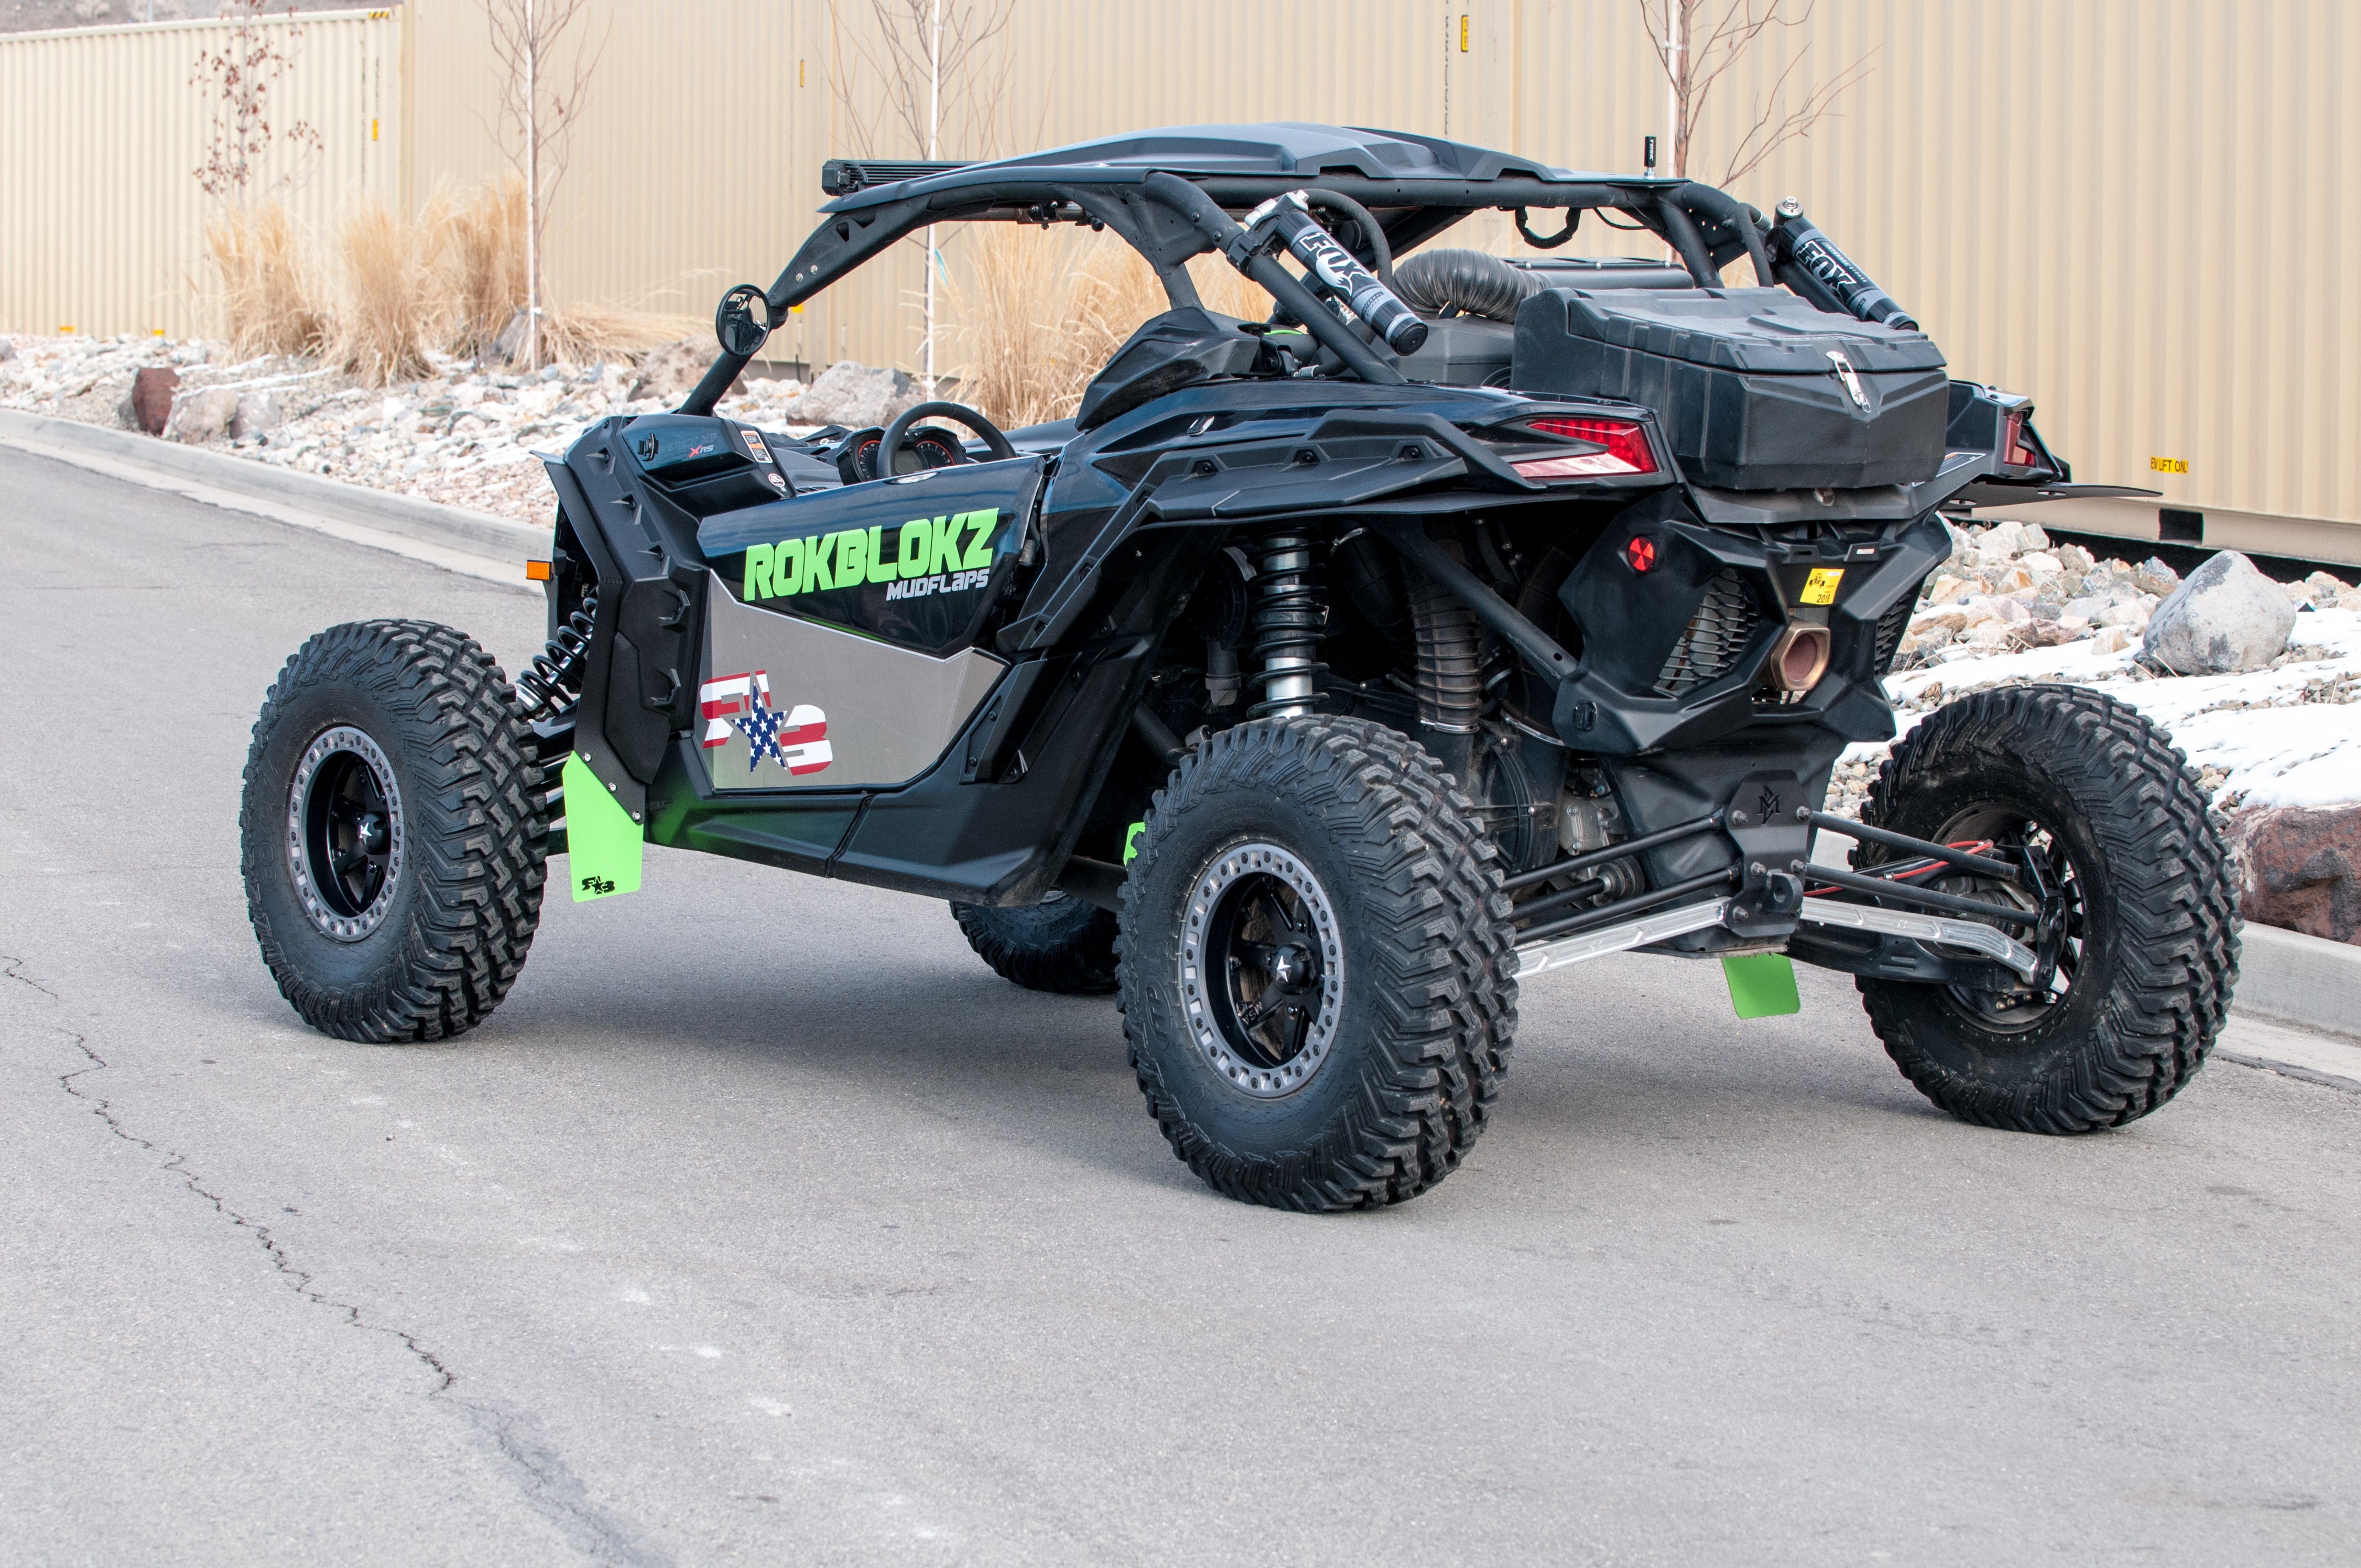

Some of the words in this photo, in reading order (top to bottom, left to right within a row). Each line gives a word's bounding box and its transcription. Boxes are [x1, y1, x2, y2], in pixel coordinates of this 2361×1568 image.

[1299, 232, 1373, 296] FOX
[1796, 240, 1857, 293] FOX
[744, 508, 999, 601] ROKBLOKZ
[1816, 594, 1831, 603] 2018
